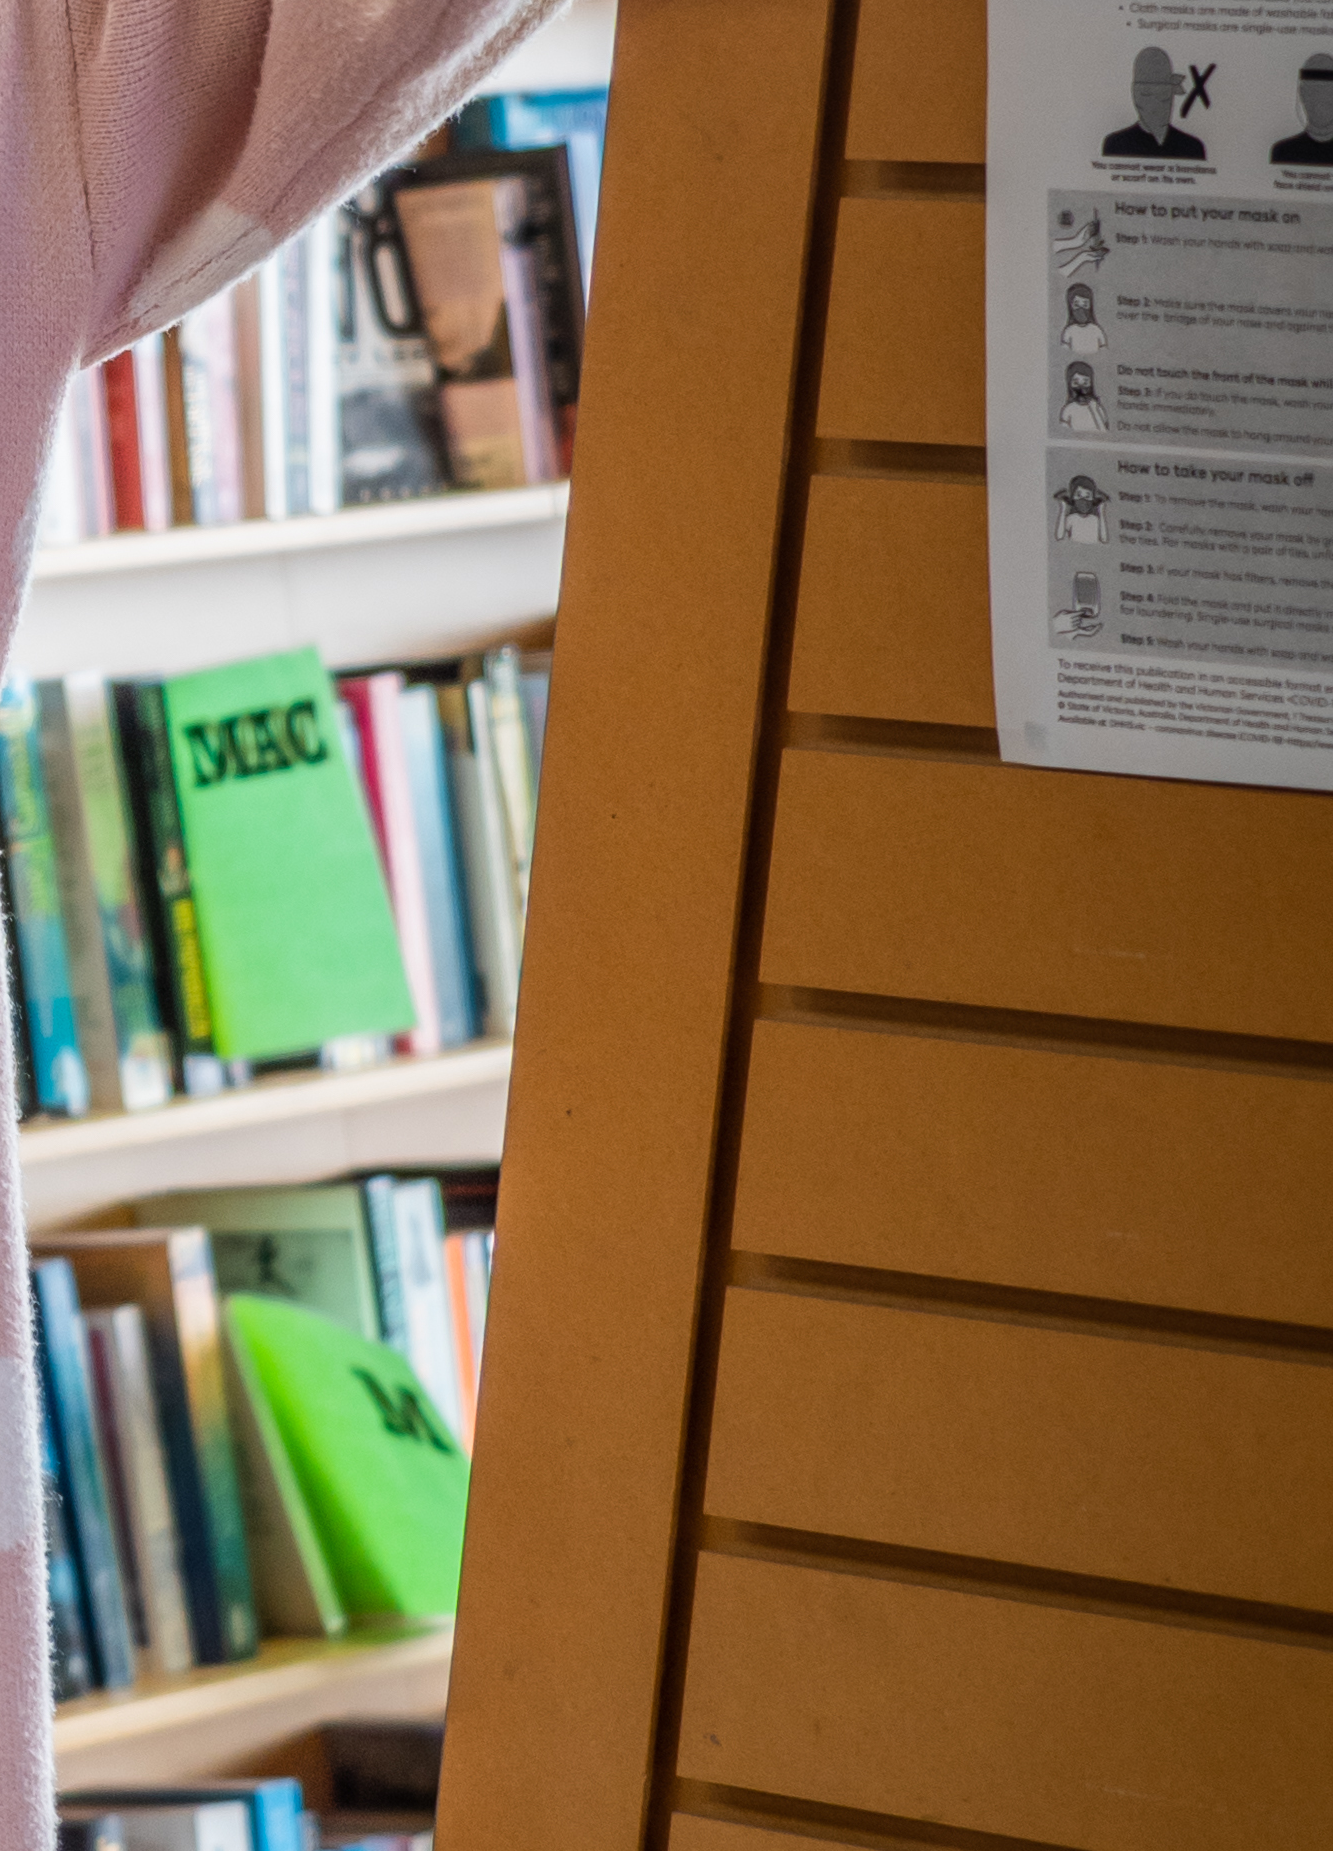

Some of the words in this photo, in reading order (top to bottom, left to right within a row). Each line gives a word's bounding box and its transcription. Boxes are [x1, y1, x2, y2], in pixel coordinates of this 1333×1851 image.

[1115, 202, 1147, 216] How
[1151, 204, 1168, 217] to
[1171, 204, 1197, 220] put
[1201, 209, 1233, 221] your
[1238, 209, 1277, 223] mask
[1283, 213, 1301, 223] on
[1118, 460, 1150, 474] How
[1155, 463, 1170, 476] to
[1174, 464, 1207, 479] take
[1210, 469, 1243, 482] your
[1248, 471, 1288, 485] mask
[1293, 472, 1314, 486] off
[183, 698, 327, 788] MAC
